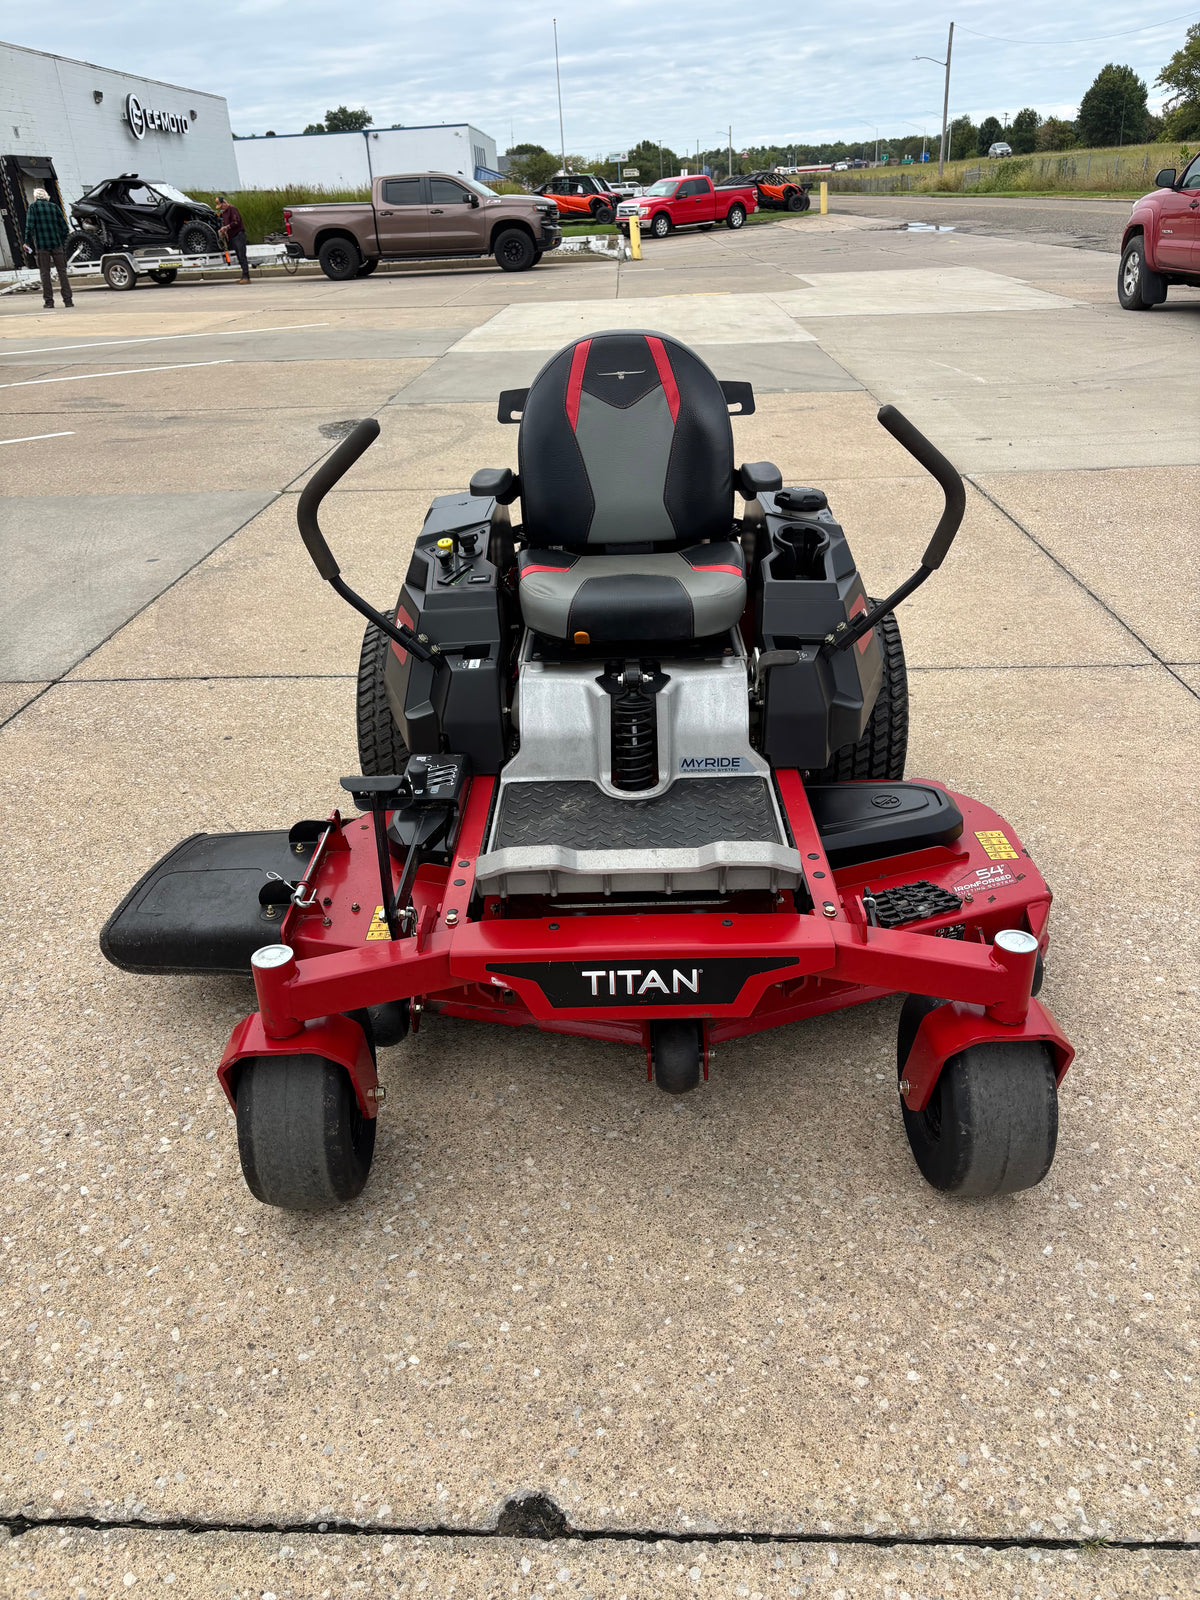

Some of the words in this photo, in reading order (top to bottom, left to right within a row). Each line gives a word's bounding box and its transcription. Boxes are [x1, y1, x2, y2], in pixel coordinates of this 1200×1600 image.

[144, 109, 189, 134] CFMOTO
[957, 886, 986, 896] CUTTING
[987, 879, 1015, 889] SYSTEM
[581, 968, 700, 996] TITAN
